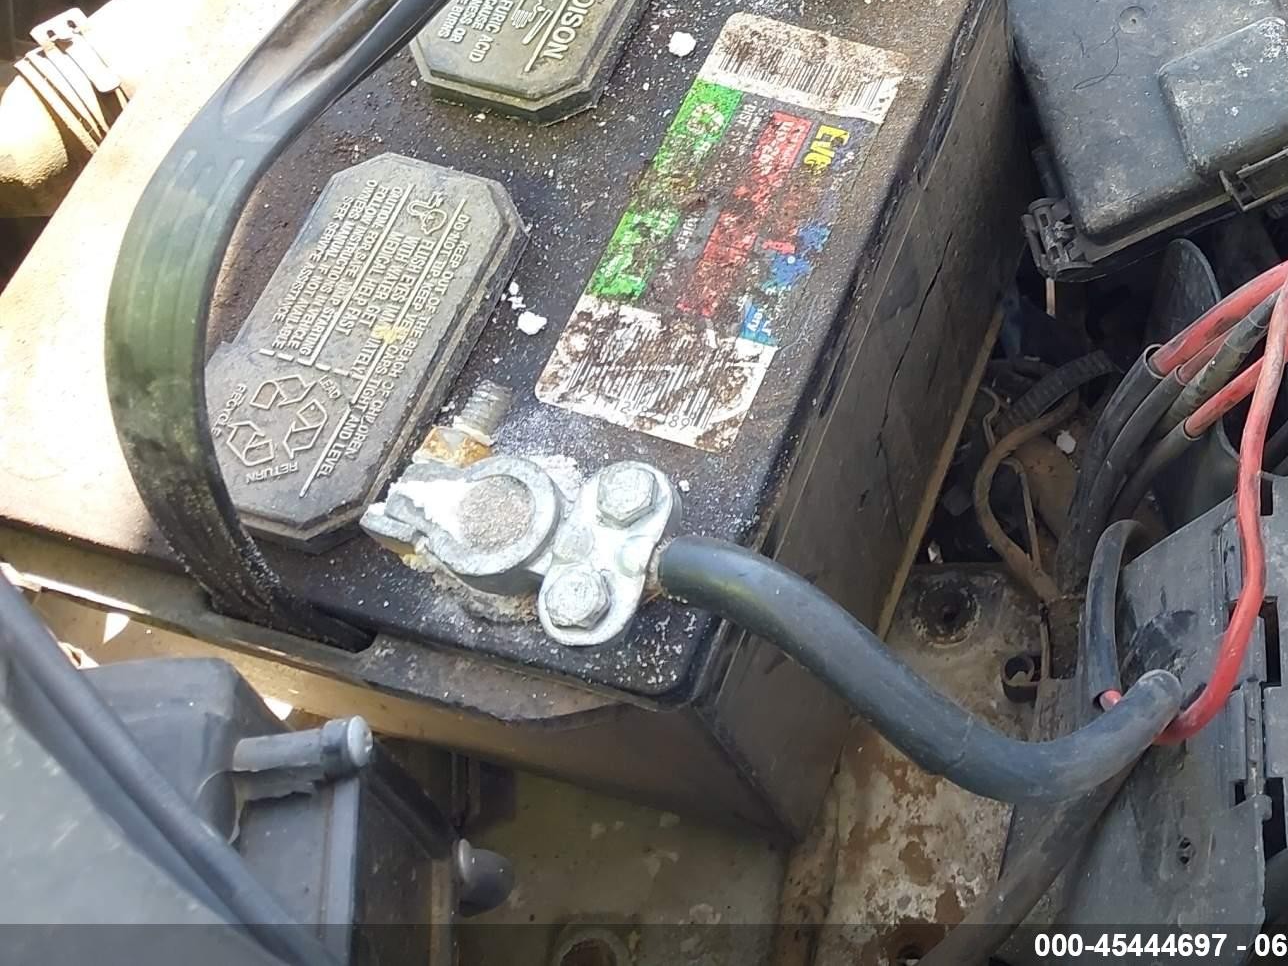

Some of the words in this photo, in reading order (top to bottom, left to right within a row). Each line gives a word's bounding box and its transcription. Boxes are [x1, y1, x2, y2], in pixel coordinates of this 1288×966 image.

[435, 5, 463, 38] BURNS
[447, 26, 466, 44] OR
[465, 35, 493, 63] ACID
[331, 194, 354, 220] SEEK
[358, 184, 390, 224] FOLLOW
[451, 214, 471, 231] DO
[307, 221, 339, 261] SERVICE
[358, 231, 379, 250] FOR
[366, 230, 404, 277] MEDICAL
[392, 233, 420, 263] WITH
[438, 230, 462, 256] NOT
[446, 240, 471, 268] KEEP
[315, 262, 330, 273] IF
[319, 225, 366, 293] INSTRUCTIONS
[342, 252, 367, 277] SAFE
[404, 239, 436, 273] FLUSH
[302, 274, 323, 296] NOT
[327, 278, 352, 305] JUMP
[351, 277, 378, 305] HELP
[388, 275, 416, 303] EYES
[408, 281, 434, 310] KEEP
[432, 271, 455, 293] OUT
[311, 294, 327, 306] IN
[422, 297, 440, 313] OF
[269, 297, 310, 350] AVAILABLE
[285, 307, 319, 349] VEHICLE
[333, 307, 362, 334] FAST
[357, 304, 381, 326] GET
[407, 314, 431, 339] THE
[298, 306, 335, 356] STARTING
[349, 304, 399, 374] IMMIATELY
[373, 344, 399, 374] CAPS
[386, 340, 416, 378] REACH
[316, 374, 342, 399] LEAD
[353, 377, 382, 410] TIGHT
[375, 381, 394, 397] OF
[207, 383, 249, 437] RECYCLE
[336, 415, 360, 441] AND
[341, 399, 385, 458] CHILDREN
[244, 461, 298, 483] RETURN
[314, 443, 345, 479] LEVEL
